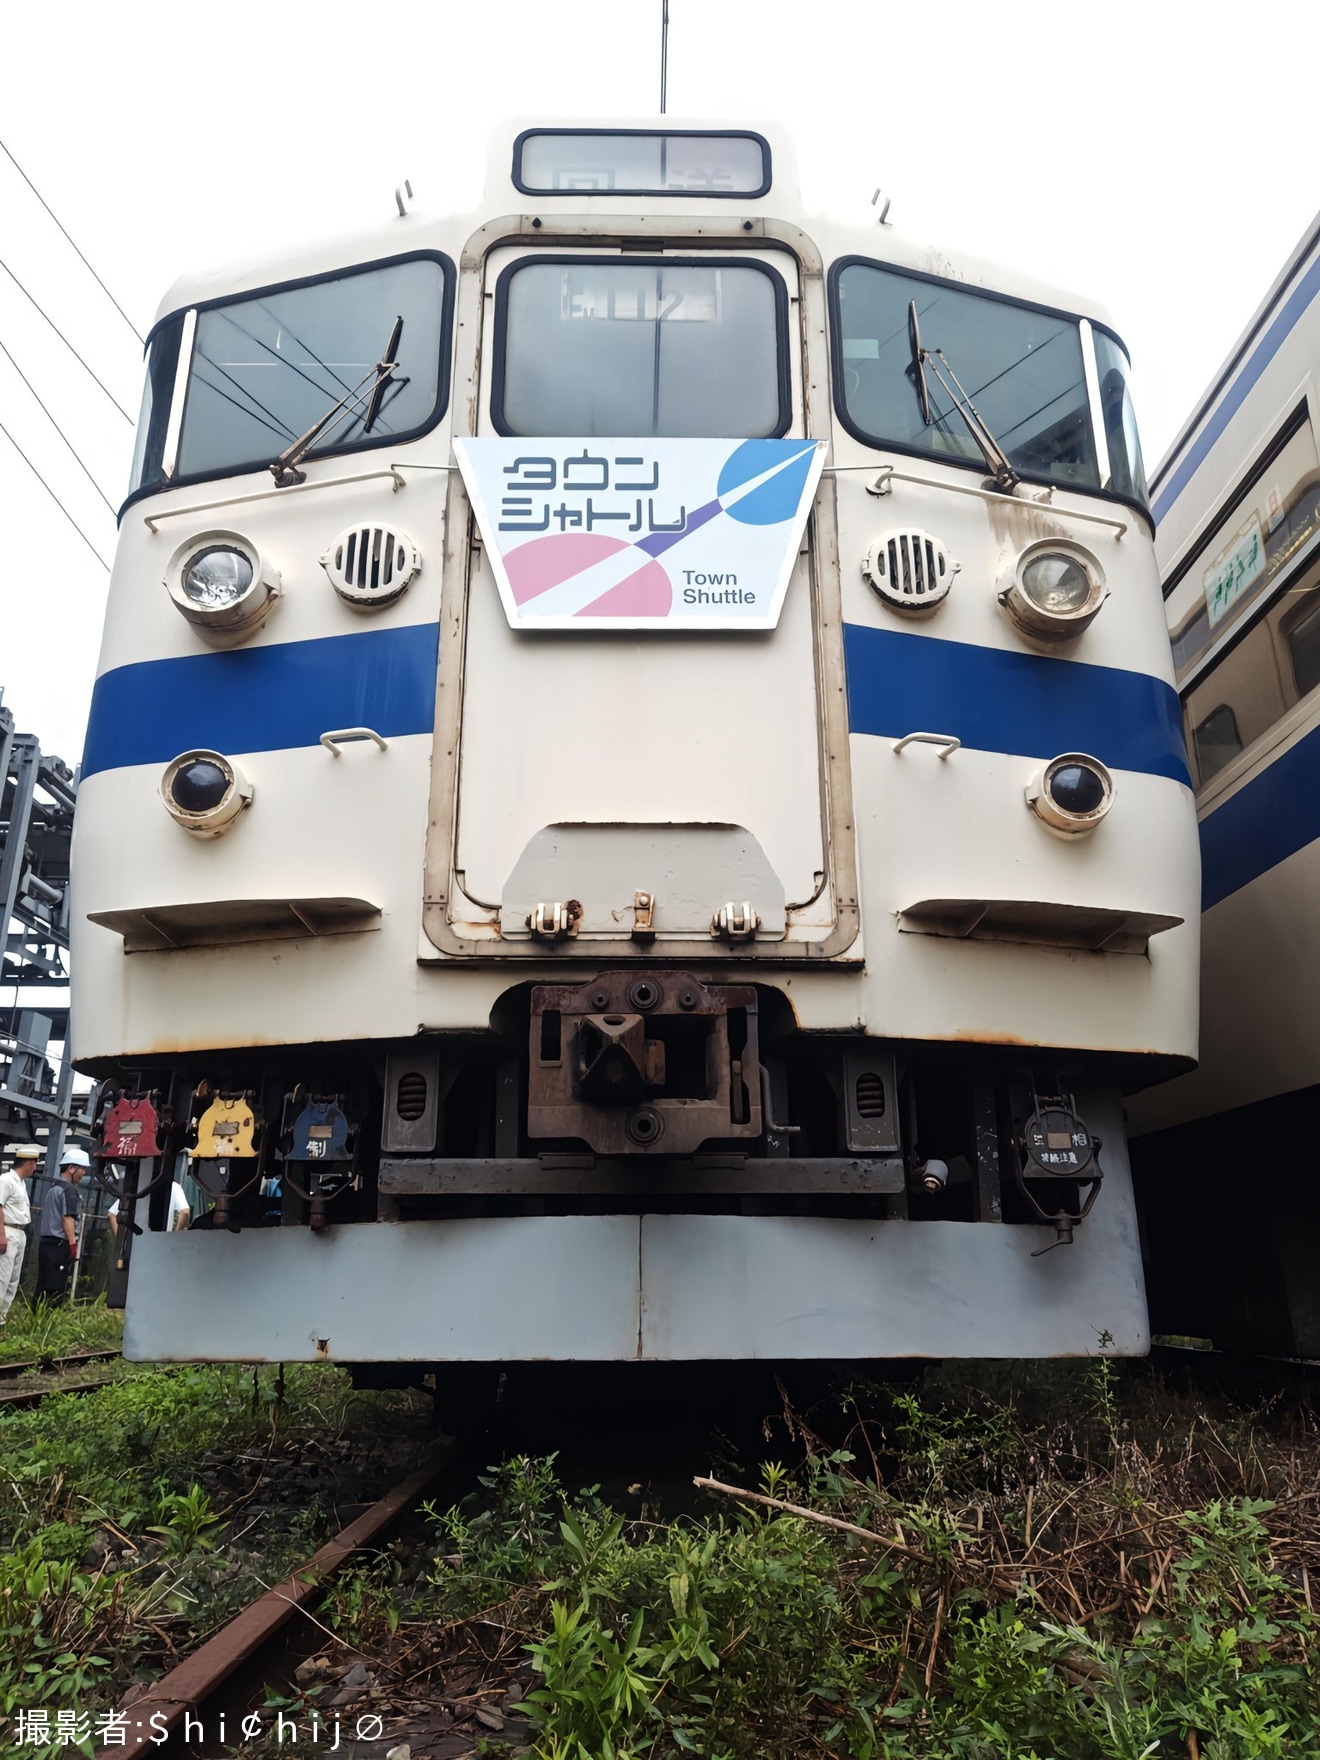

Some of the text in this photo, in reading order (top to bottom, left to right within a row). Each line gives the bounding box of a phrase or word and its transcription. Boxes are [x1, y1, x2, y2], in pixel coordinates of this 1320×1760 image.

[503, 448, 659, 491] タウン
[498, 497, 687, 532] シャトル
[682, 569, 738, 586] Town
[682, 588, 757, 605] Shuttle
